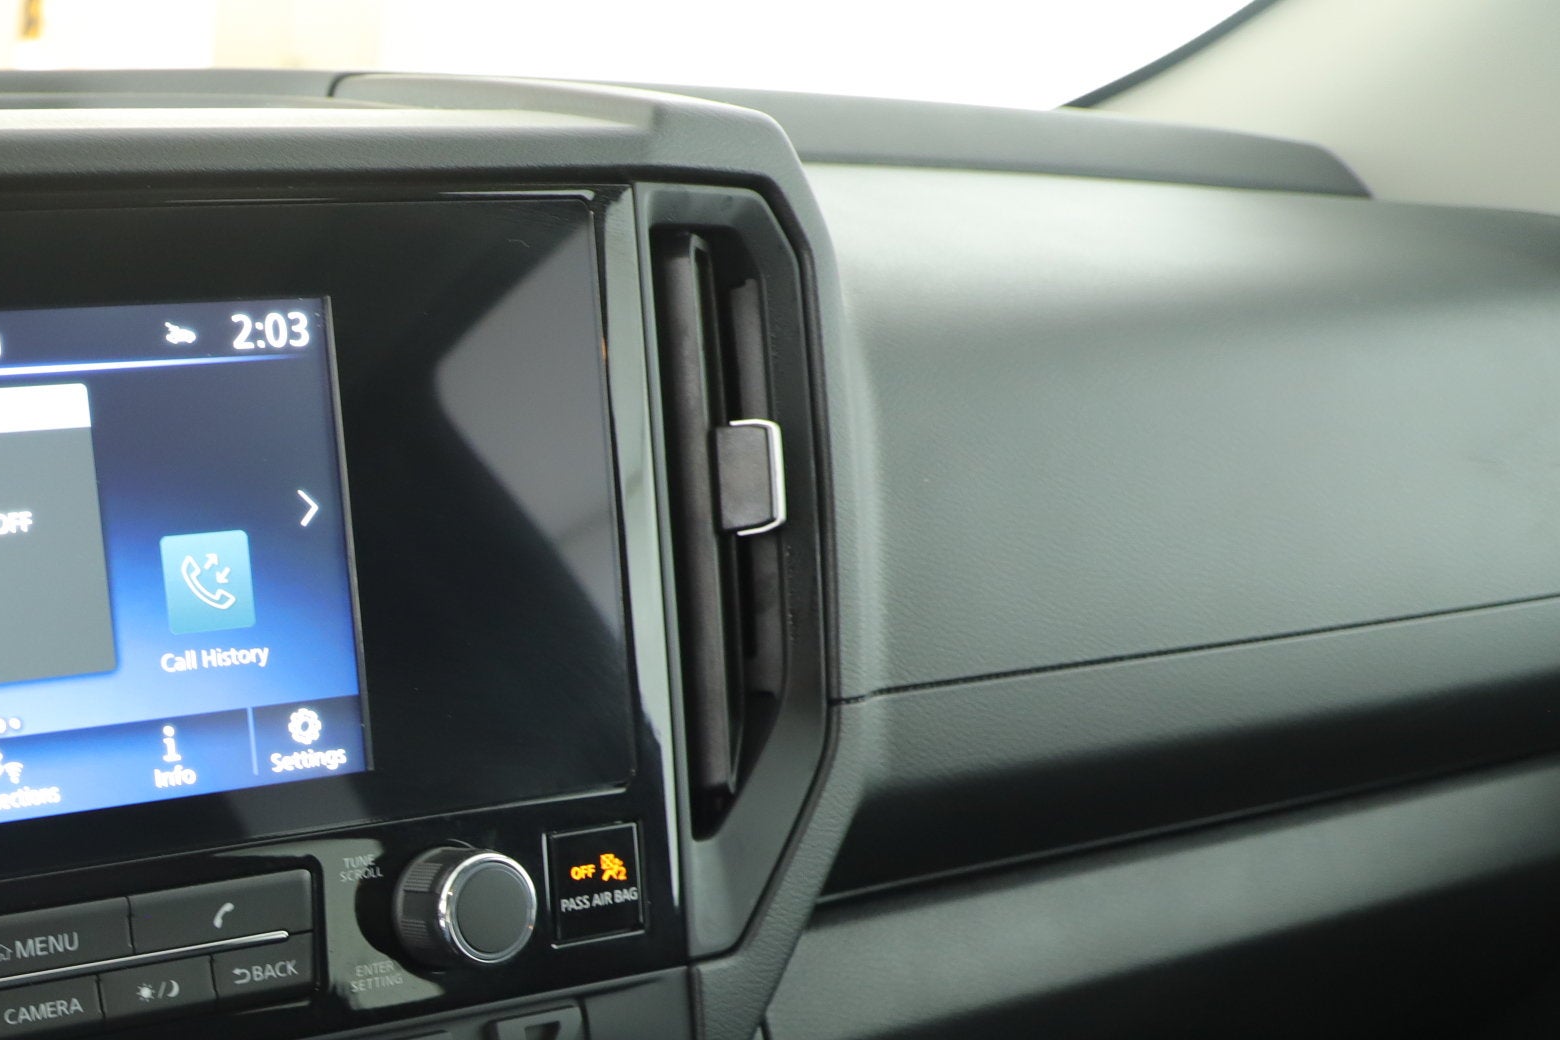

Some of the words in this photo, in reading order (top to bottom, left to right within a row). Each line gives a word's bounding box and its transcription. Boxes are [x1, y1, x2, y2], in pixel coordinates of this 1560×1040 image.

[231, 311, 312, 351] 2:03
[160, 650, 198, 673] Call
[201, 647, 270, 669] History
[270, 748, 348, 773] Settings
[154, 764, 198, 789] Info
[339, 865, 385, 882] SCROLL
[343, 854, 376, 869] TUNE
[570, 863, 597, 881] OFF
[560, 895, 591, 912] PASS
[591, 891, 613, 907] AIR
[613, 886, 639, 904] BAG
[14, 931, 80, 960] MENU
[251, 959, 298, 983] BACK
[355, 960, 396, 977] ENTER
[349, 973, 405, 993] SETTING
[3, 997, 84, 1026] CAMERA
